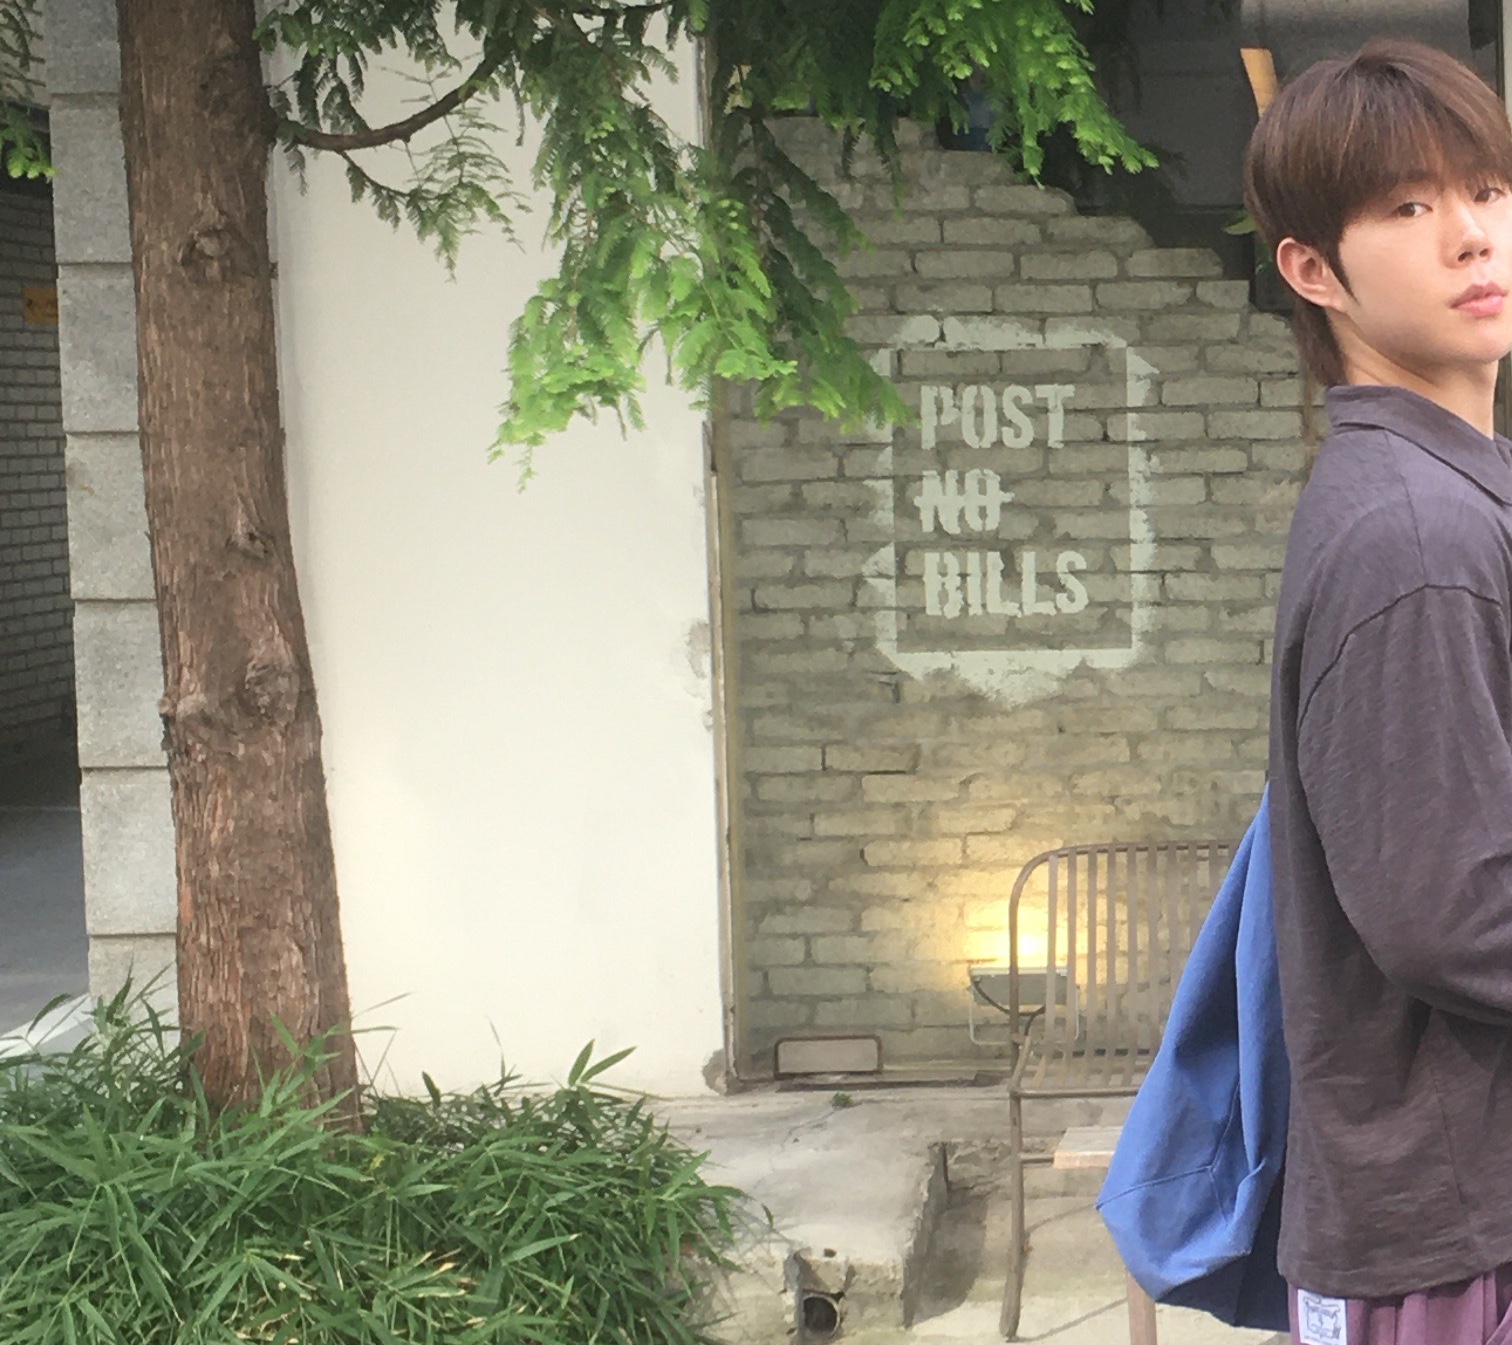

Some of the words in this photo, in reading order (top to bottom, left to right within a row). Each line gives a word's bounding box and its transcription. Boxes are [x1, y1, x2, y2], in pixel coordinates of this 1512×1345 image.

[921, 384, 1075, 450] POST
[916, 468, 1008, 534] NO
[923, 551, 1089, 618] BILLS
